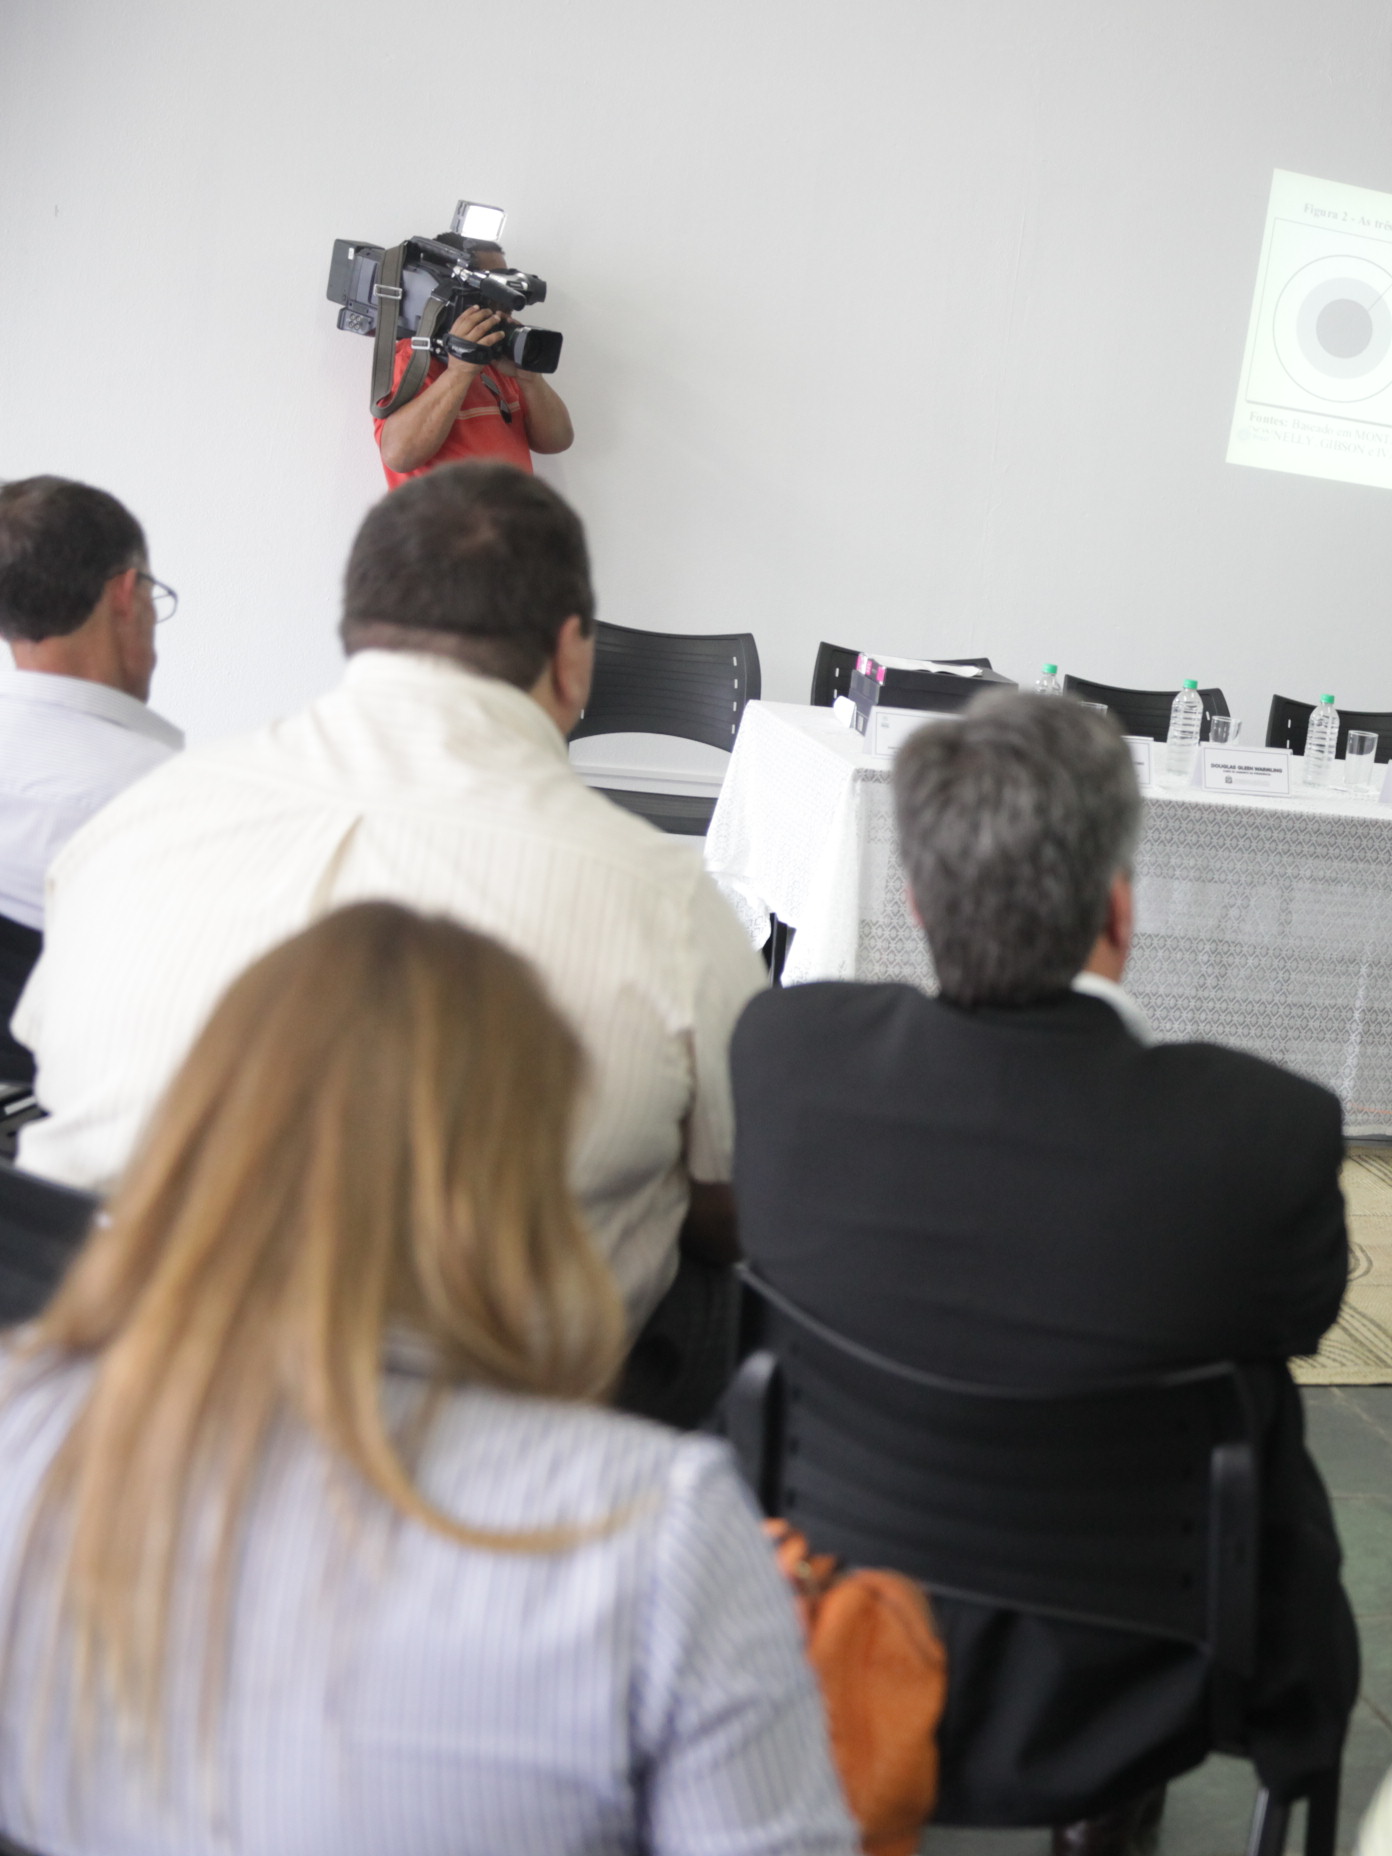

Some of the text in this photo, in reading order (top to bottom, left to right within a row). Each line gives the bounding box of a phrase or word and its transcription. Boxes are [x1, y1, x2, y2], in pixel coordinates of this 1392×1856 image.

[1304, 203, 1338, 219] Figura
[1341, 211, 1348, 222] 2
[1359, 216, 1370, 226] As
[1374, 219, 1392, 231] três
[1249, 411, 1288, 427] Fontes:
